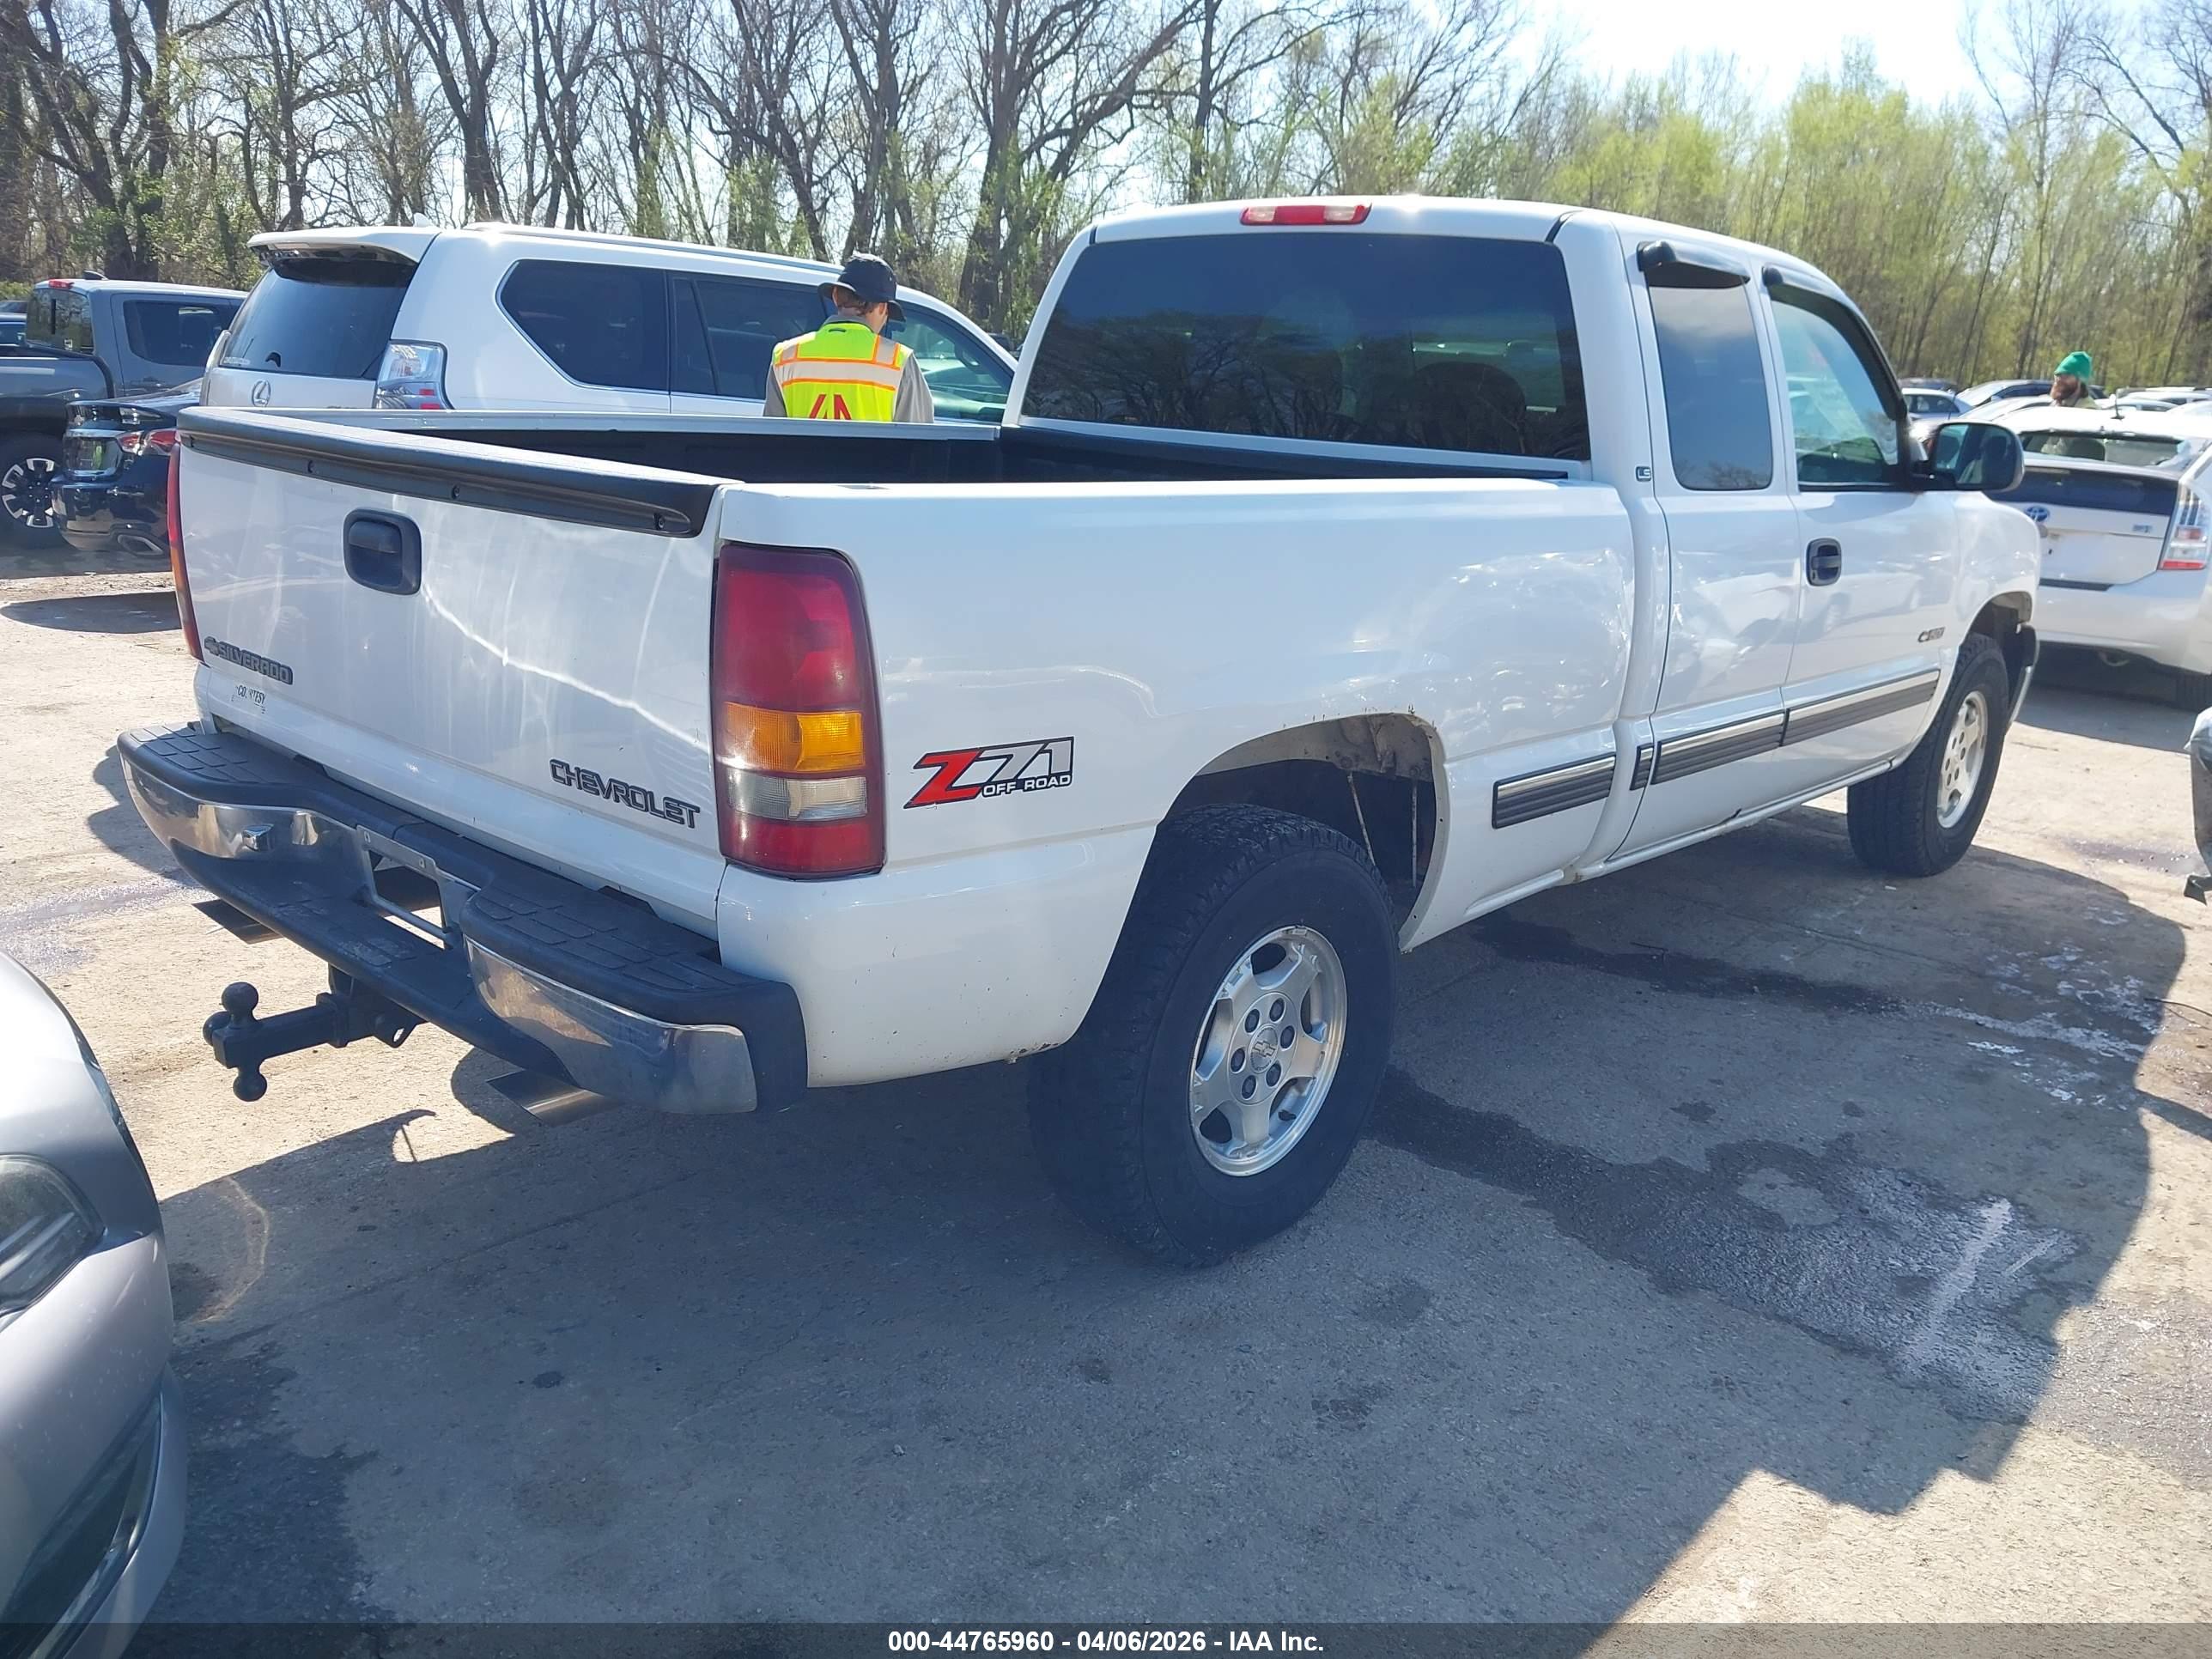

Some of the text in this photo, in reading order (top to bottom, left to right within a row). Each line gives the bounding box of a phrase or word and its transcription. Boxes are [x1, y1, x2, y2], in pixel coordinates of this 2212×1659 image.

[217, 640, 293, 685] SILVERADO
[549, 758, 701, 830] CHEVROLET
[902, 736, 1074, 809] Z71
[981, 773, 1073, 798] OFF ROAD
